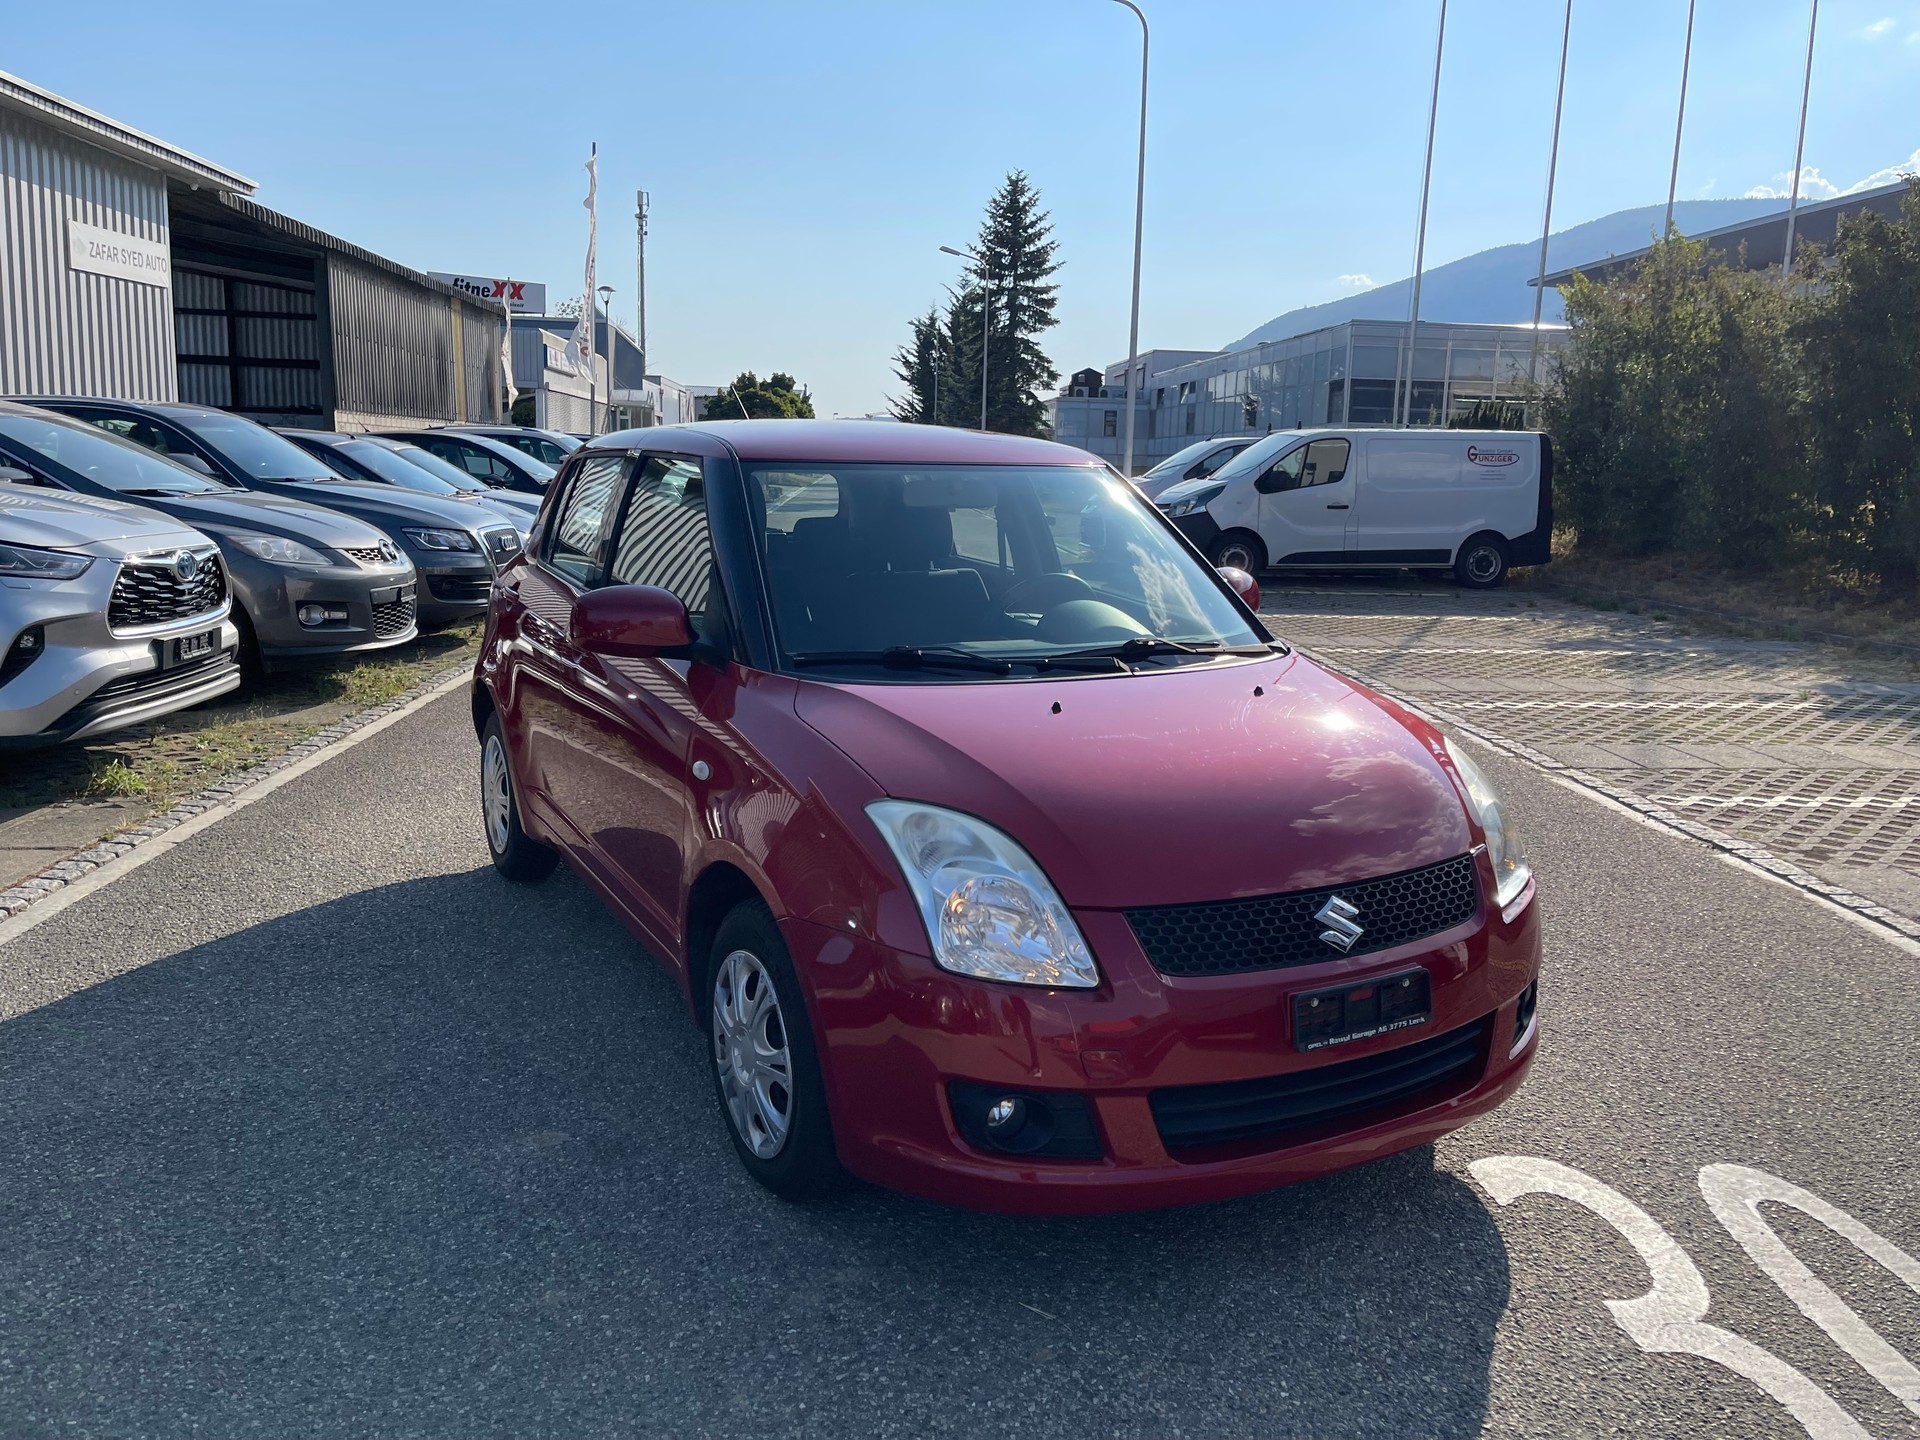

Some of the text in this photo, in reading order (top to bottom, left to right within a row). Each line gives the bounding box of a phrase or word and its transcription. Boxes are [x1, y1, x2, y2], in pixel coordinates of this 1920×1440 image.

[89, 241, 167, 273] ZAFAR SYED AUTO
[1352, 1028, 1377, 1040] Garage
[1377, 1024, 1388, 1034] AG
[1389, 1020, 1408, 1031] 3775
